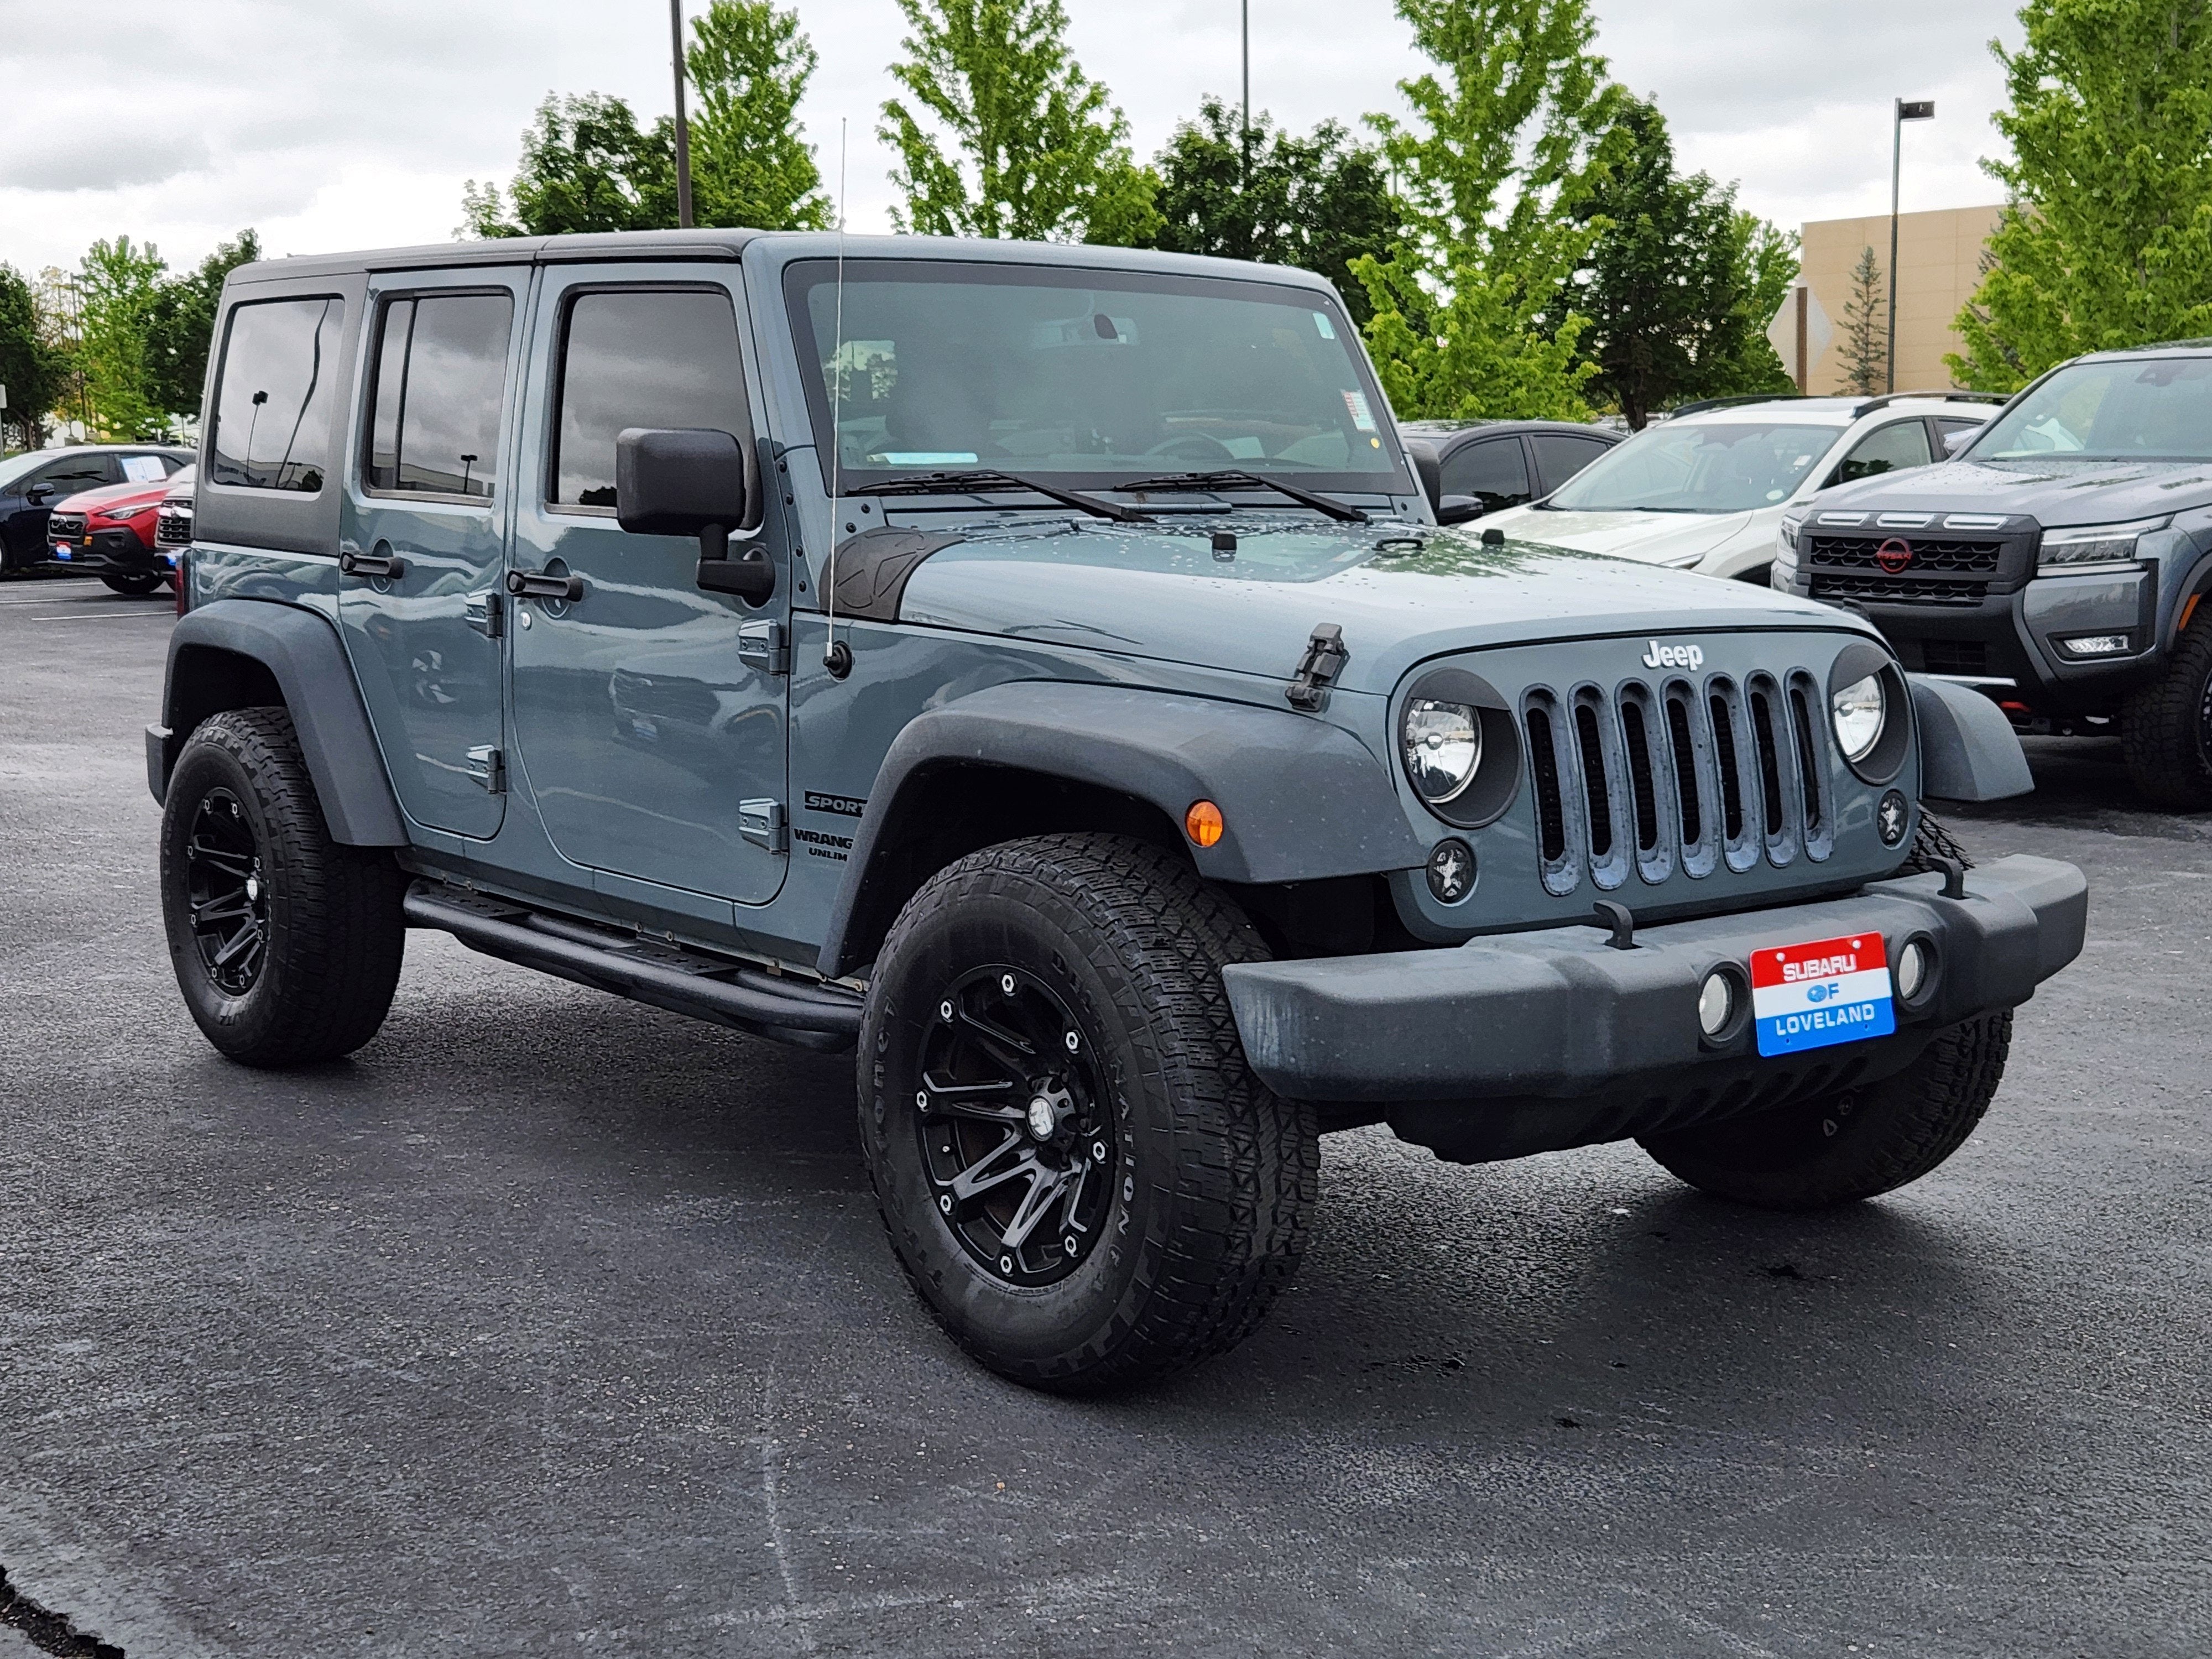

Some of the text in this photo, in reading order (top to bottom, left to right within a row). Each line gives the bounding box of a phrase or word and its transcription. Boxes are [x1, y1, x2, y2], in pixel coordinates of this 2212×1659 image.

[1642, 640, 1704, 671] Jeep
[808, 795, 868, 814] SPORT
[1783, 953, 1857, 982] SUBARU
[1807, 983, 1840, 1003] OF
[1775, 1003, 1875, 1036] LOVELAND
